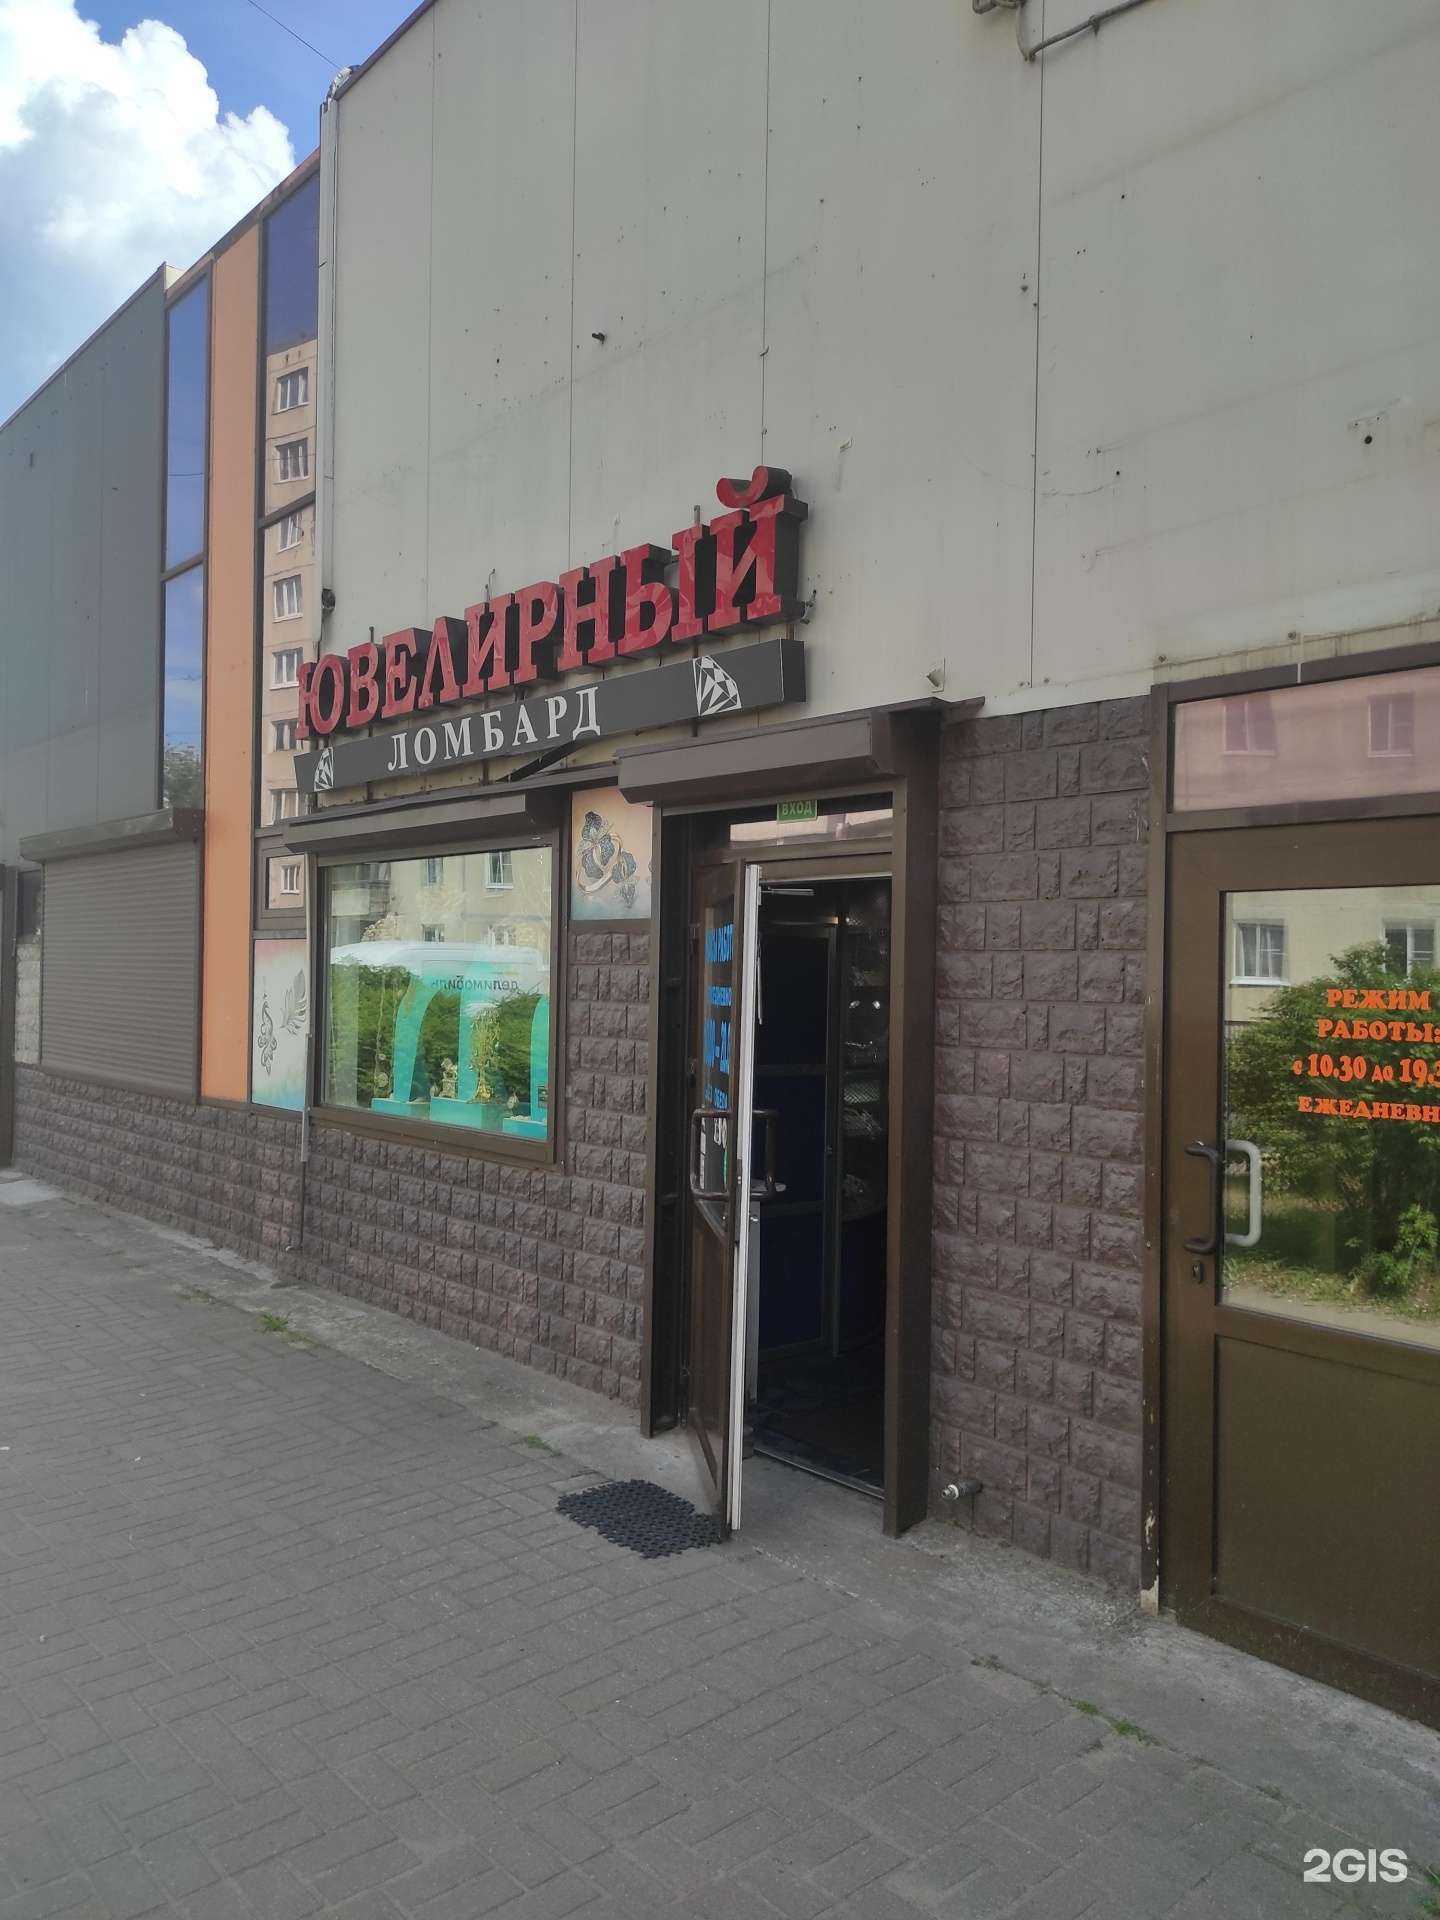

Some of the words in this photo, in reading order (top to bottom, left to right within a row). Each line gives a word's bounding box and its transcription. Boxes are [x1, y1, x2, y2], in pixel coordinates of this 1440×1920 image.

[297, 465, 792, 740] ЮВЕЛИРНЫЙ
[387, 686, 601, 771] ЛОМБАРД
[782, 800, 814, 816] ВХОД
[1326, 988, 1431, 1011] РЕЖИМ
[1316, 1018, 1440, 1043] РАБОТЫ:
[1307, 1053, 1367, 1082] 10.30
